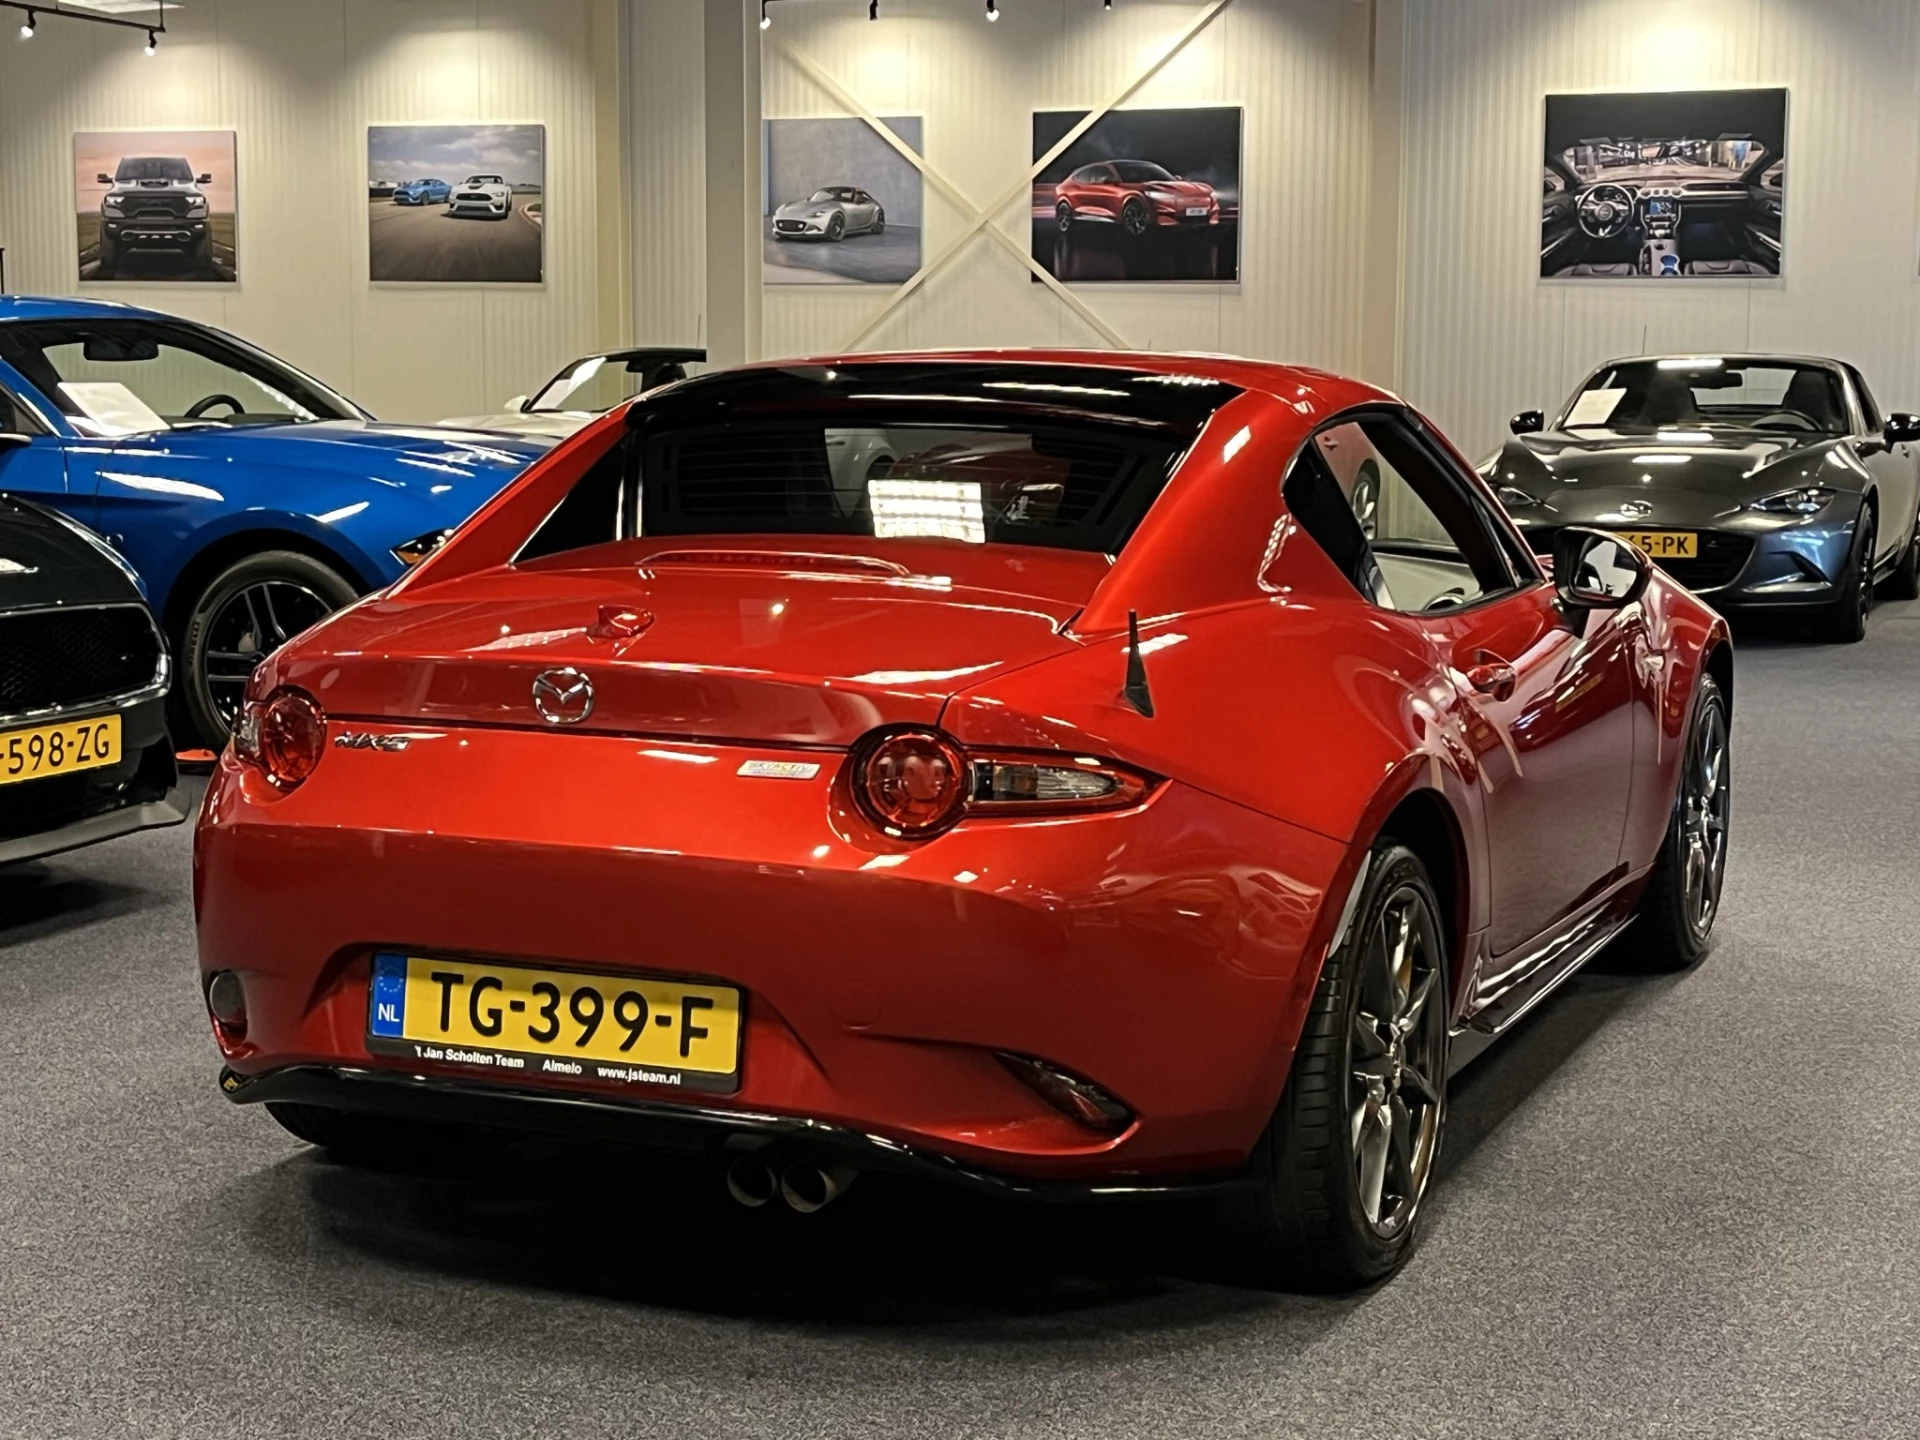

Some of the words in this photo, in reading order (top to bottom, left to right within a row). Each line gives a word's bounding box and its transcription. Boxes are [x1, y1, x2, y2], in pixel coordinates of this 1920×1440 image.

[378, 1002, 400, 1022] NL
[430, 971, 713, 1058] TG-399-F
[423, 1047, 443, 1060] Jan
[445, 1049, 493, 1065] Scholten
[494, 1054, 524, 1068] Team
[542, 1059, 582, 1074] Almelo
[597, 1066, 681, 1085] www.jsteam.nl
